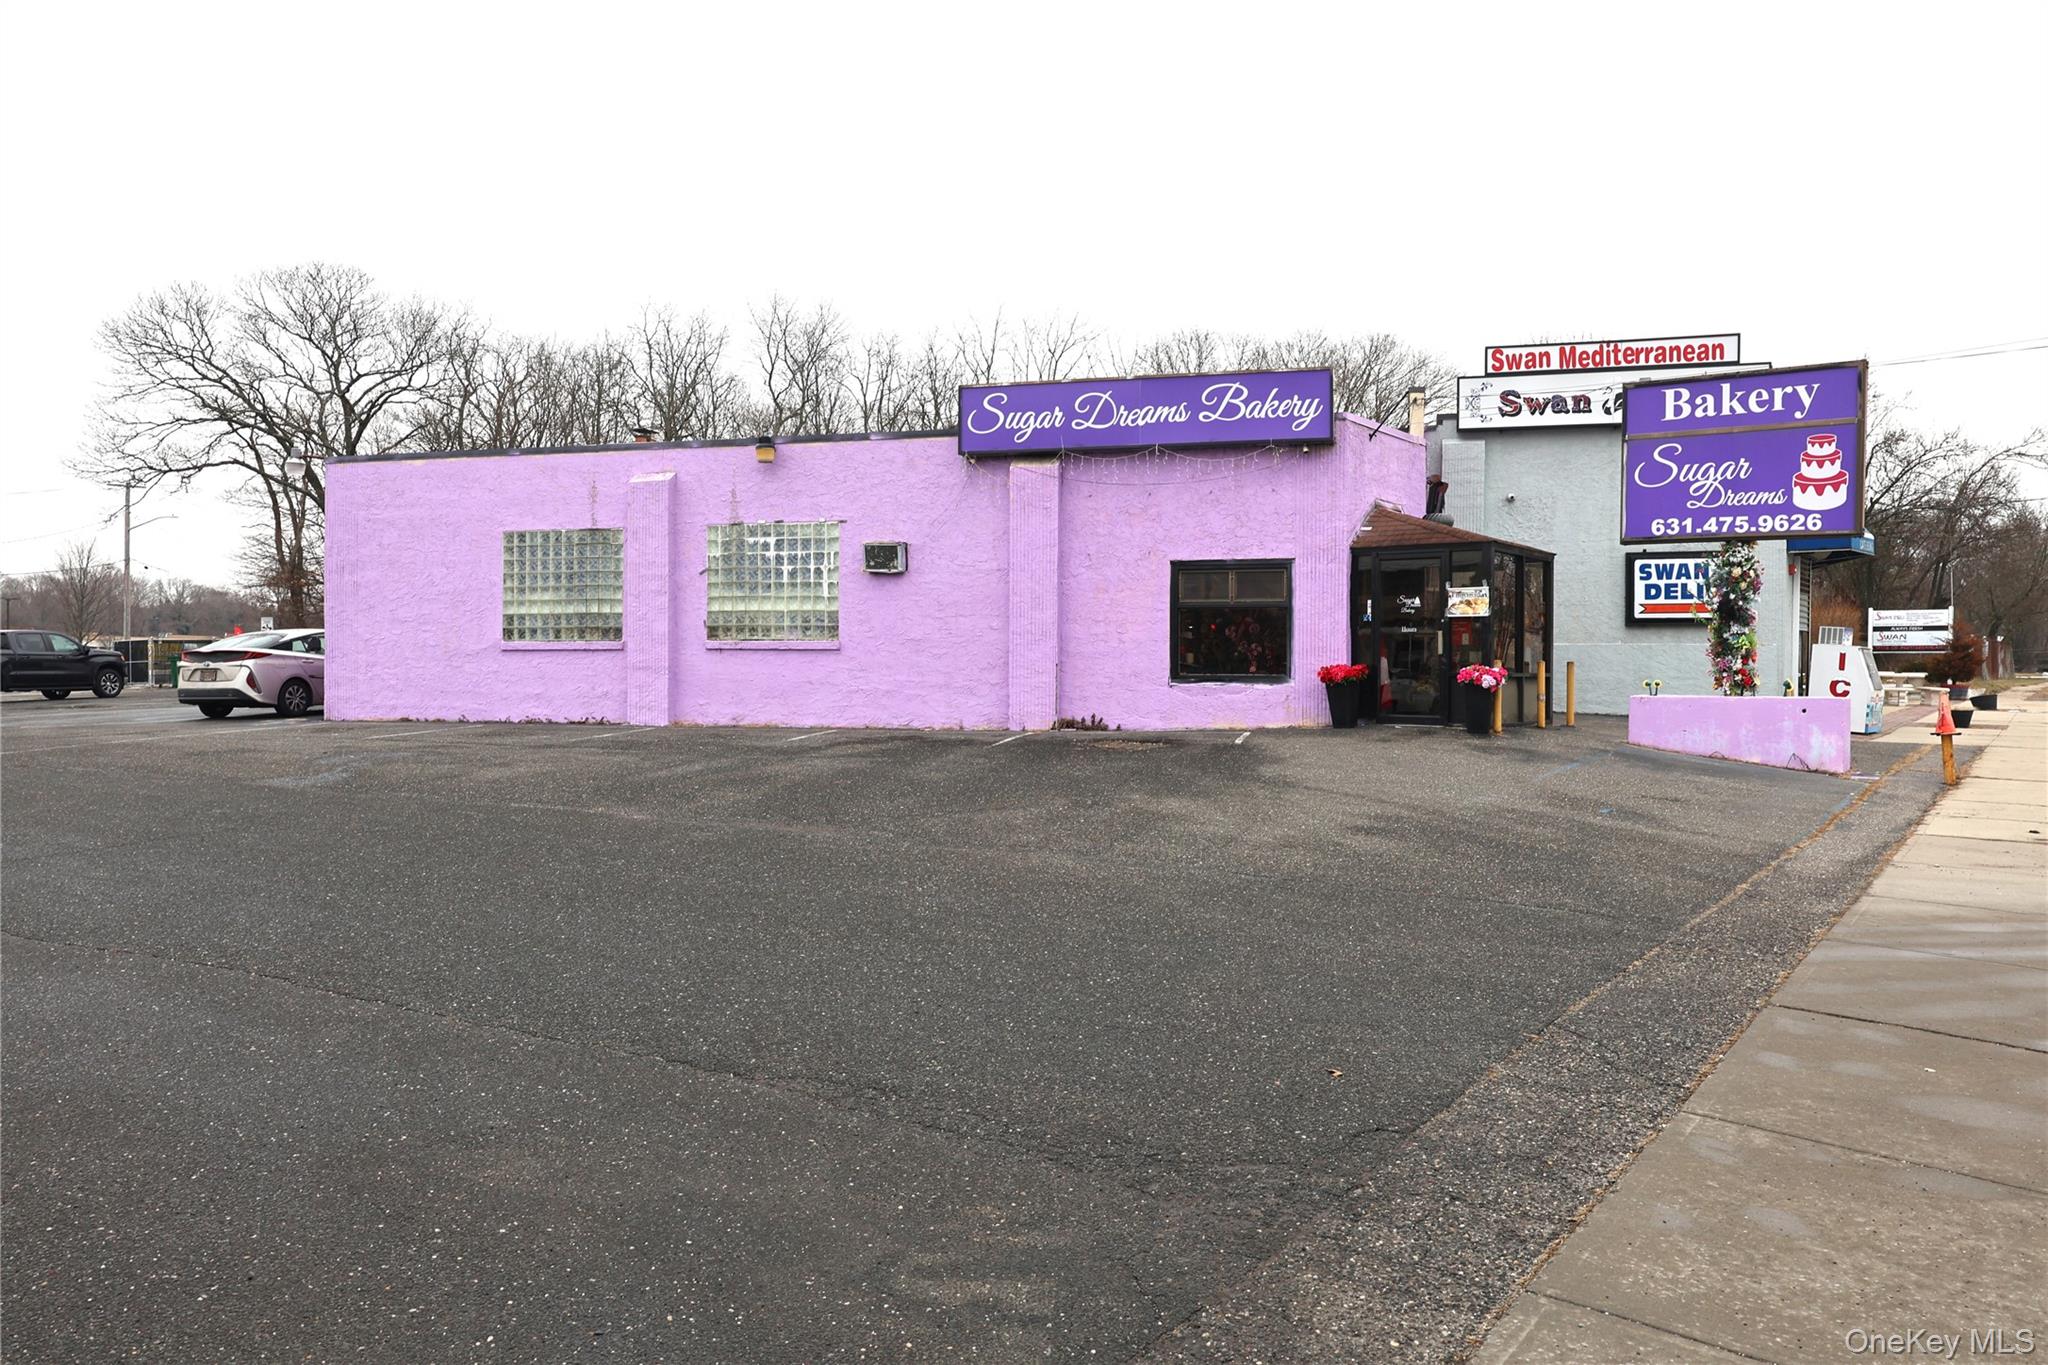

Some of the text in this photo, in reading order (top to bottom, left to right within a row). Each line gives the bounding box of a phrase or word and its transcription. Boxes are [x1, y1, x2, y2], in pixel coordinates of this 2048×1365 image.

[1491, 342, 1725, 372] Swan Mediterranean
[967, 382, 1324, 443] Sugar Dreams Bakery
[1498, 390, 1593, 418] Swan
[1661, 383, 1821, 422] Bakery
[1634, 442, 1752, 494] Sugar
[1686, 480, 1788, 509] Dreams
[1650, 513, 1822, 536] 631.475.9626
[1639, 563, 1709, 580] SWAN
[1644, 583, 1705, 600] DELI
[1877, 631, 1907, 641] SWAN
